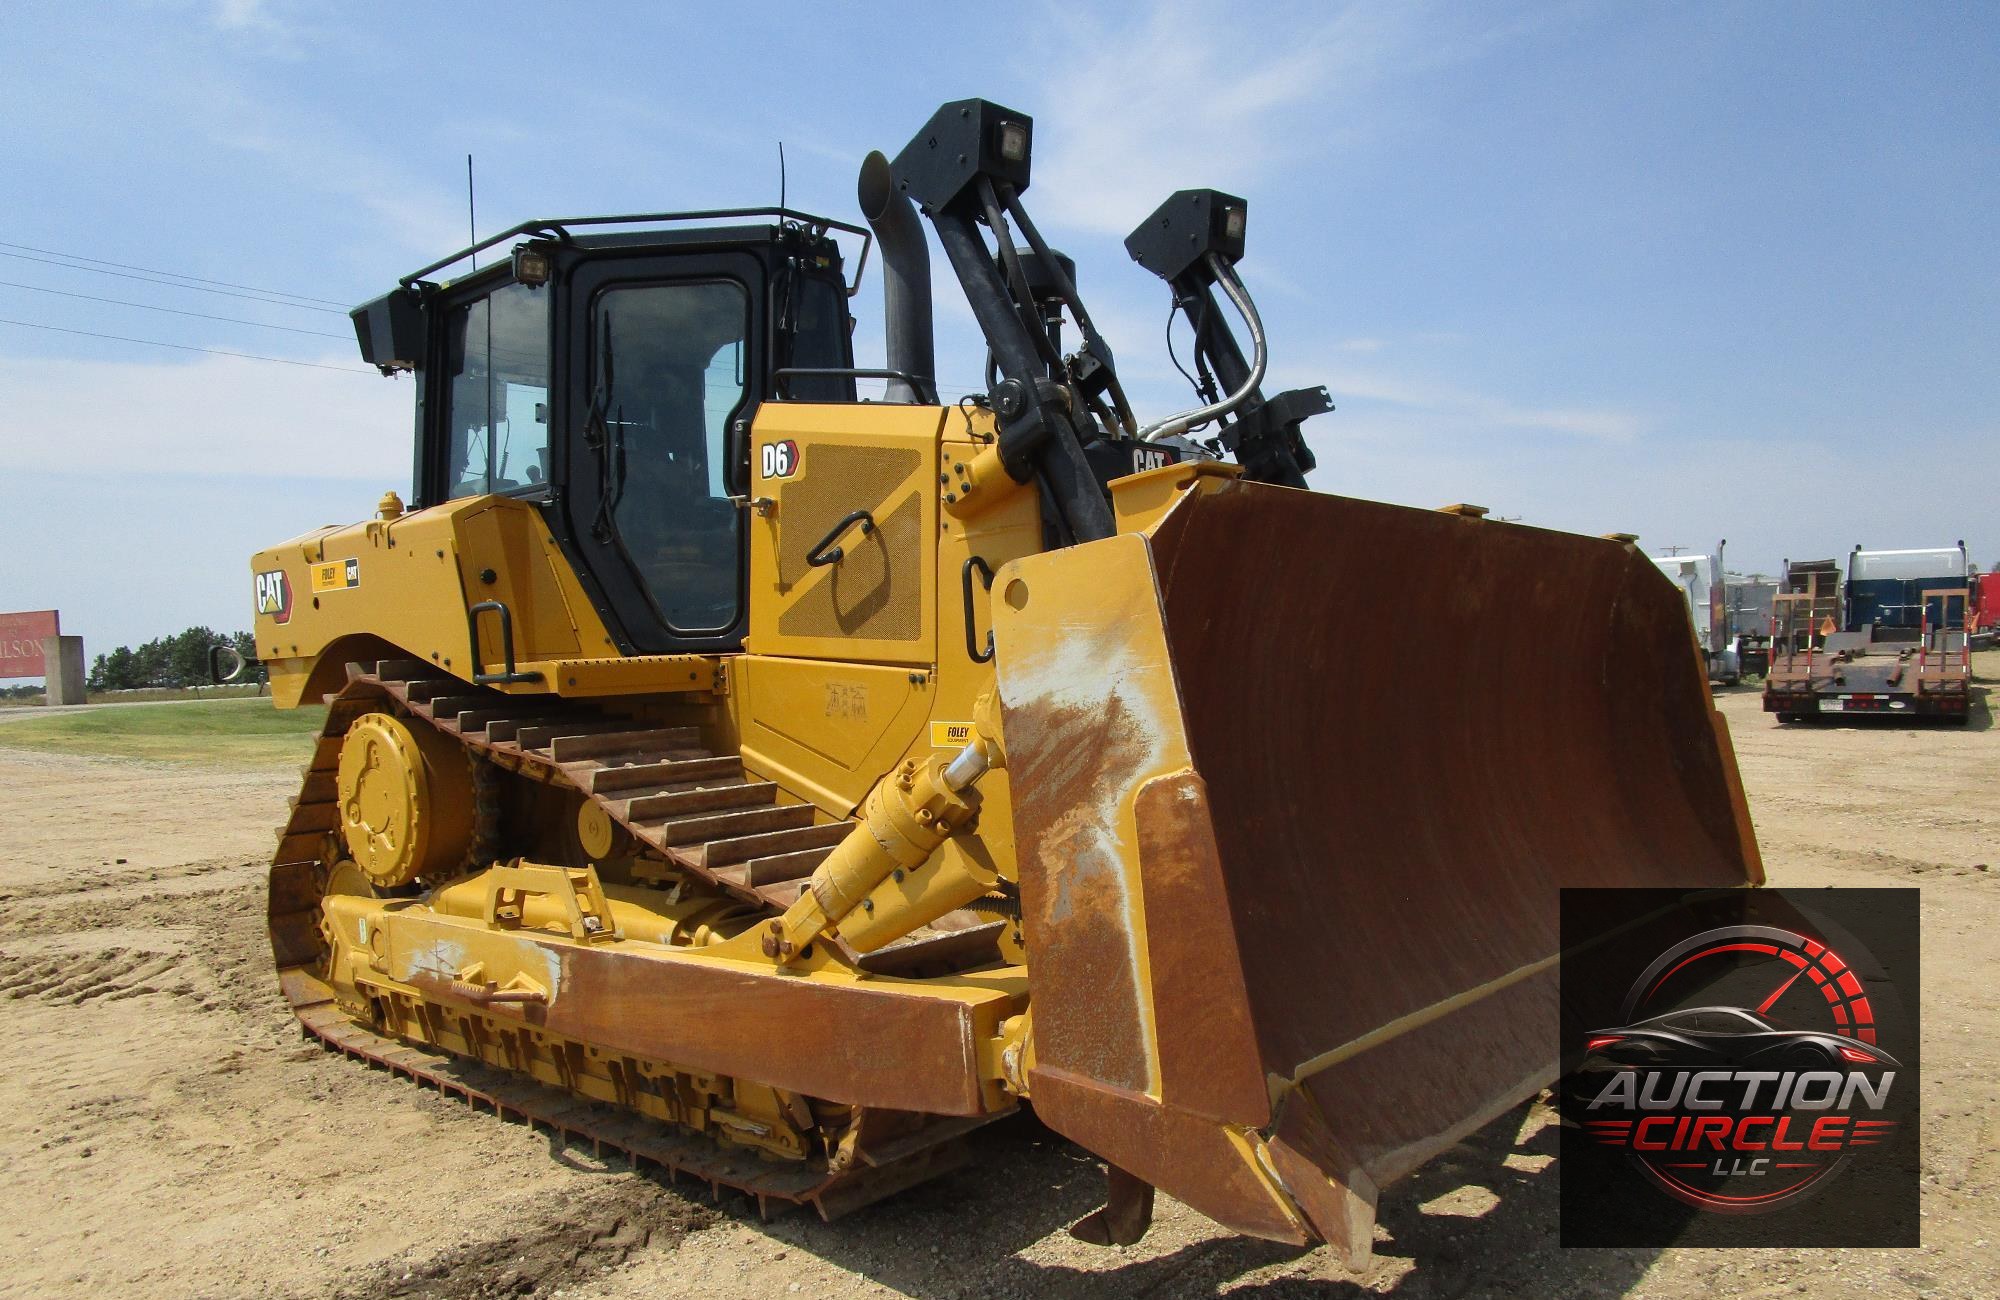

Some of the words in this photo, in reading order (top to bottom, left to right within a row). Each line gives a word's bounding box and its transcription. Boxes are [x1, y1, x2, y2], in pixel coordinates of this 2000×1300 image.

[762, 442, 788, 477] D6
[1133, 448, 1165, 474] CAT
[322, 567, 336, 581] FOLEY
[346, 565, 358, 581] CAT
[256, 571, 283, 613] CAT
[947, 726, 970, 738] FOLEY
